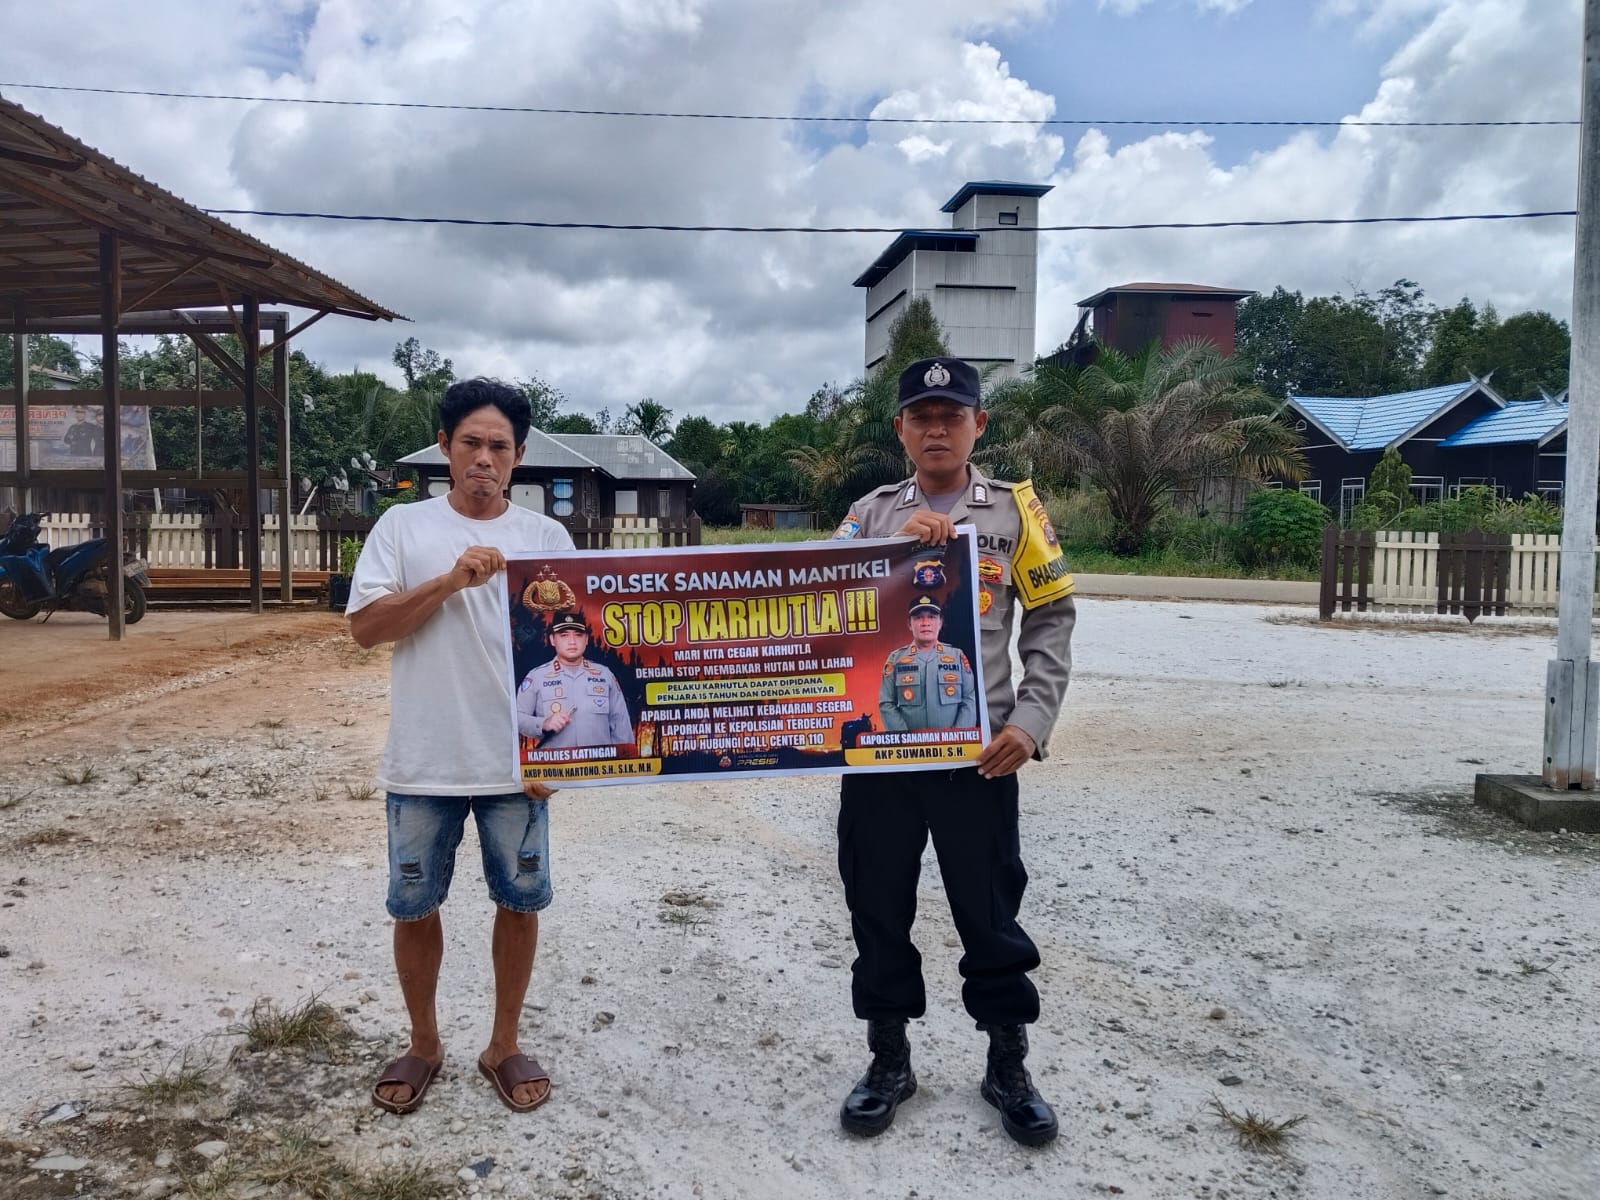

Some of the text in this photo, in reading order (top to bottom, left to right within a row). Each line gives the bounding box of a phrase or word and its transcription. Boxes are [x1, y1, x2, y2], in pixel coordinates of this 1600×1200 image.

[977, 534, 1012, 554] OLRI
[586, 558, 890, 594] POLSEK SANAMAN MANTIKEI
[604, 589, 878, 647] STOP KARHUTLA !!!
[674, 643, 811, 661] MARI KITA CEGAH KARHUTLA
[635, 656, 853, 678] DENGAN STOP MEMBAKAR HUTAN DAN LAHAN
[938, 663, 959, 671] POLRI
[667, 677, 823, 691] PELAKU KARHUTLA DAPAT DIPIDANA
[657, 693, 697, 701] PENJARA
[740, 690, 758, 698] DAN
[760, 689, 791, 697] DENDA
[802, 686, 834, 694] MILYAR
[641, 700, 853, 721] APABILA ANDA MELIHAT KEBAKARAN SEGERA
[661, 717, 833, 736] LAPORKAN KE KEPOLISIAN TERDEKAT
[672, 733, 824, 751] ATAU HUBUNGI CALL CENTER 110
[860, 730, 979, 745] KAPOLSEK SANAMAN MANTIKEI
[527, 747, 617, 762] KAPOLRES KATINGAN
[875, 749, 894, 760] AKP
[524, 768, 541, 778] AKBP
